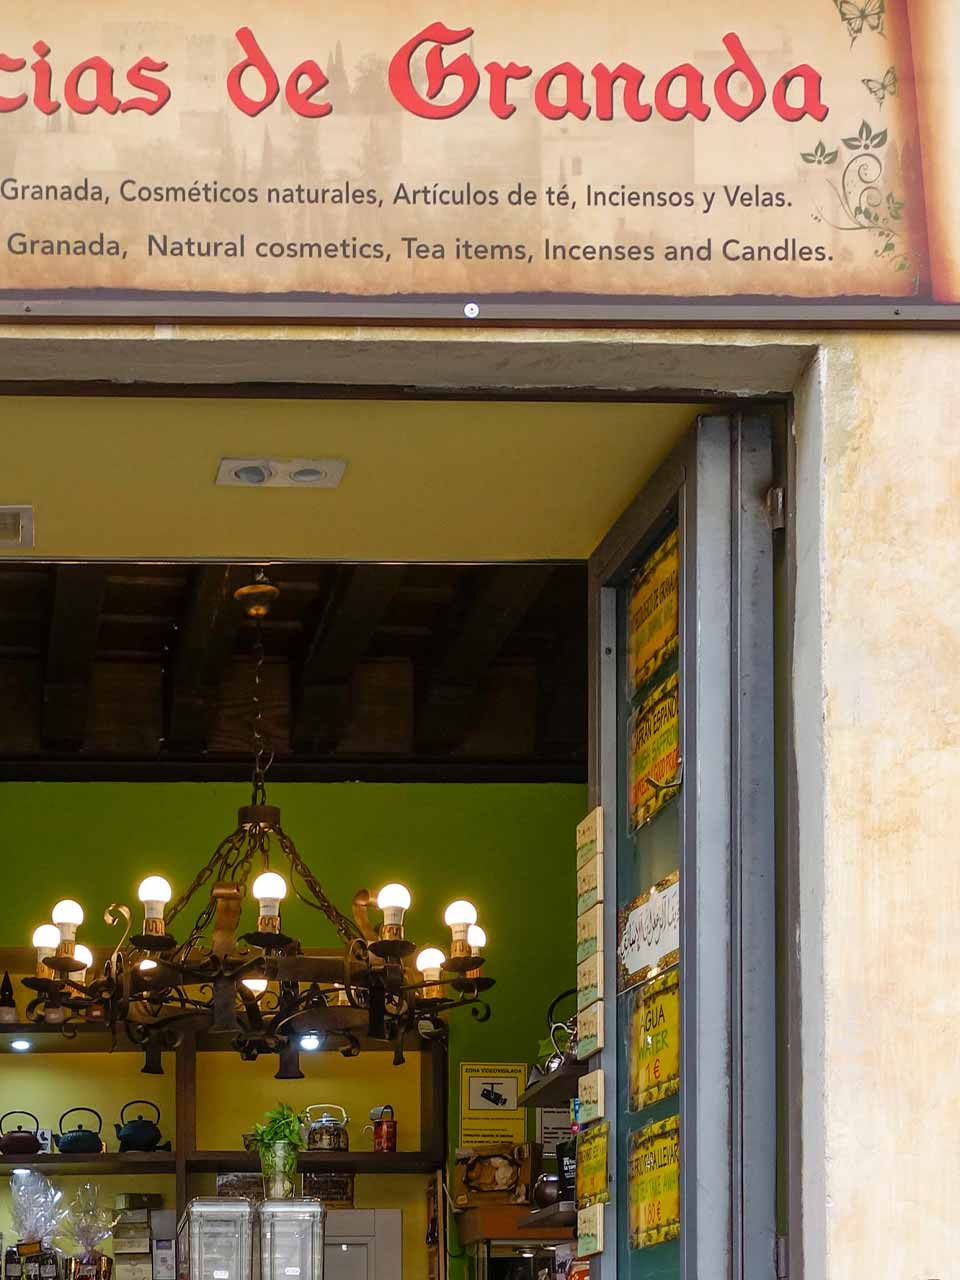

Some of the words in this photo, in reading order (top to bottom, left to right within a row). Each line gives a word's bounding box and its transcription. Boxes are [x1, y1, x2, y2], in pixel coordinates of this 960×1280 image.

[226, 27, 332, 120] de
[388, 21, 830, 123] Granada
[0, 177, 111, 206] Granada,
[120, 179, 259, 204] Cosméticos
[266, 180, 384, 208] naturales,
[393, 182, 499, 206] Artículos
[508, 182, 538, 206] de
[545, 183, 577, 210] té,
[585, 184, 694, 208] Inciensos
[702, 190, 717, 212] y
[724, 185, 793, 208] Velas.
[6, 232, 128, 260] Granada,
[147, 233, 246, 258] Natural
[255, 234, 392, 263] cosmetics,
[401, 236, 447, 261] Tea
[455, 236, 534, 266] items,
[543, 238, 655, 262] Incenses
[664, 238, 712, 262] and
[721, 238, 834, 264] Candles.
[640, 1003, 666, 1032] AGUA
[653, 1058, 661, 1080] €
